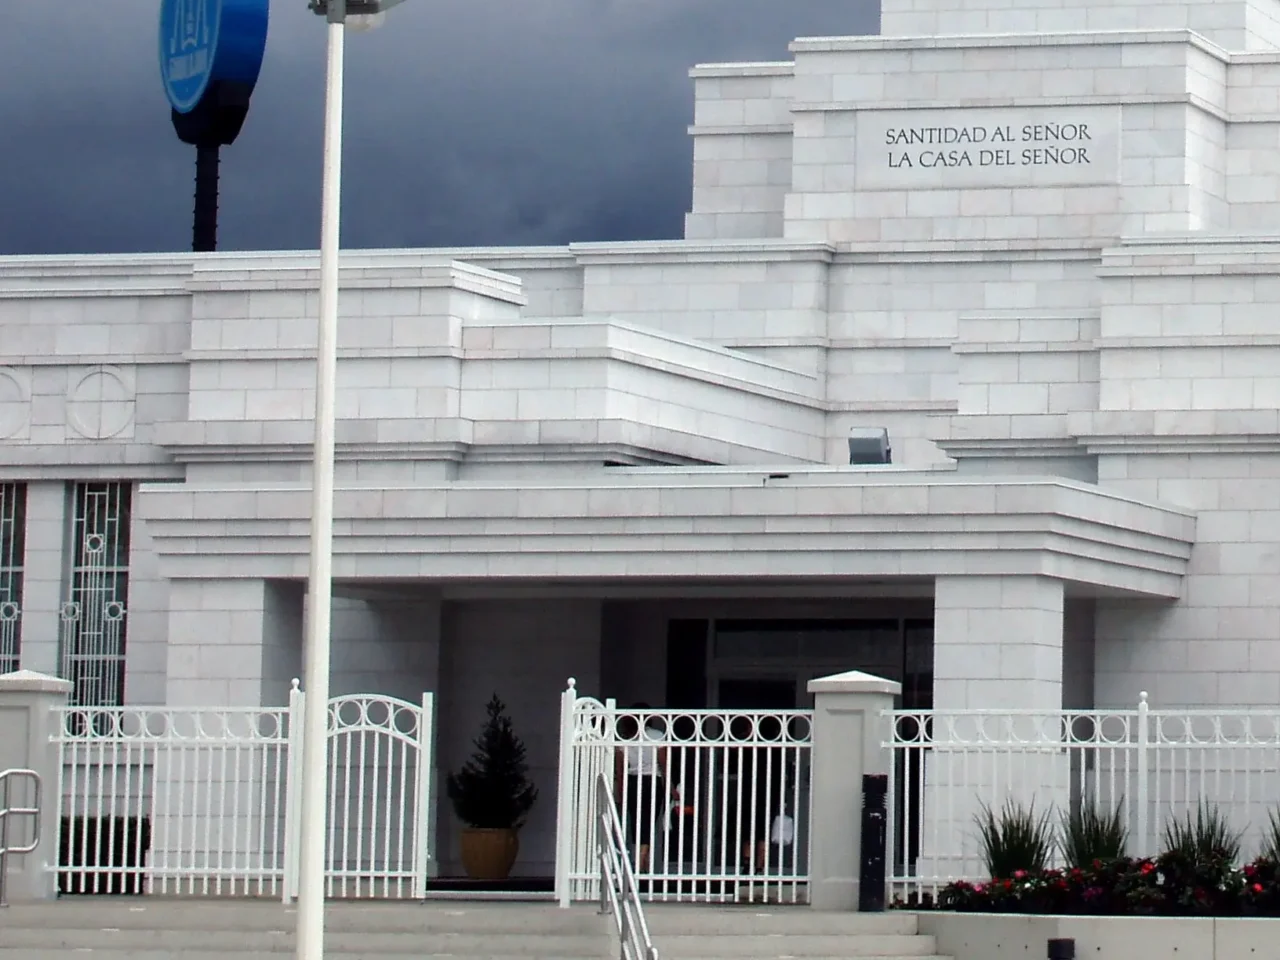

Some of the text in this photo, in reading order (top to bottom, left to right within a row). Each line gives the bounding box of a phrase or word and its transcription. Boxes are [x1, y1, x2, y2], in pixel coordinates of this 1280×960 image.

[885, 122, 1092, 146] SANTIDAD AL SEÑOR
[887, 145, 1091, 169] LA CASA DEL SEÑOR
